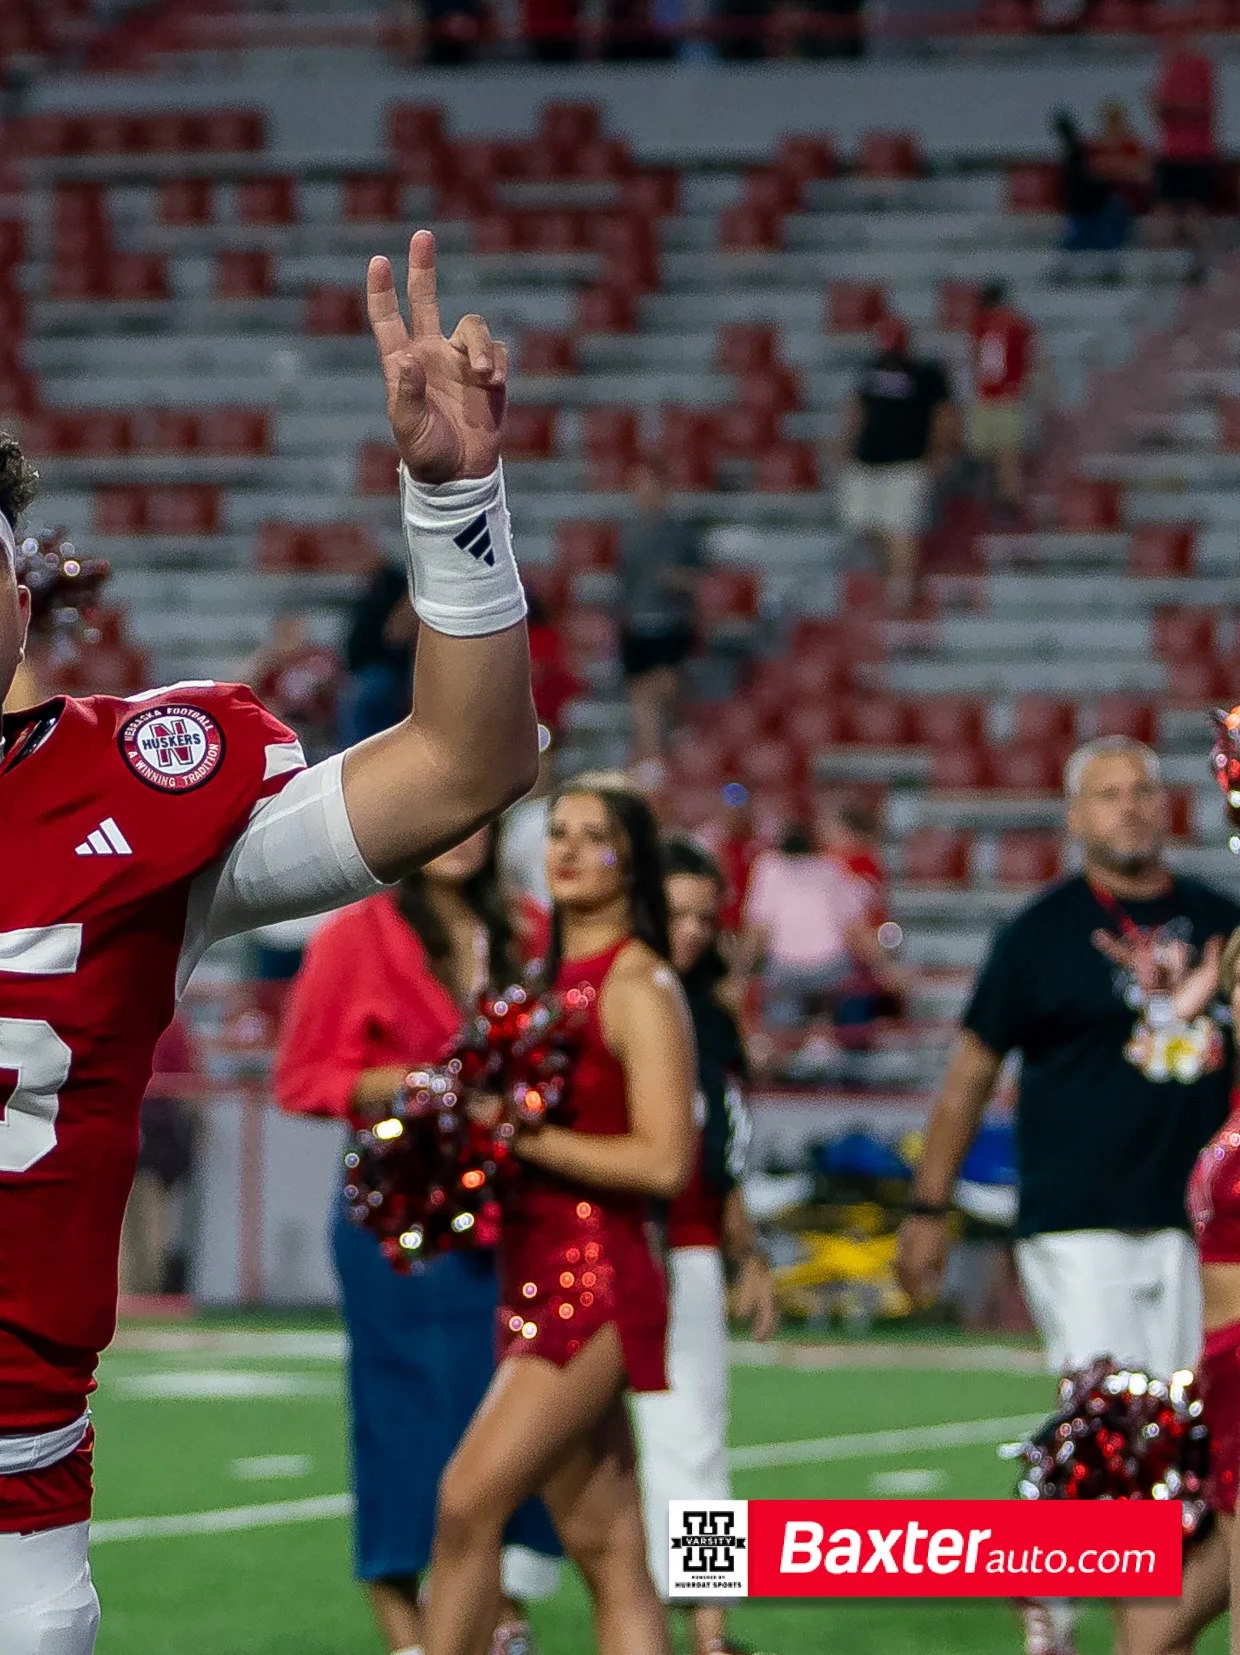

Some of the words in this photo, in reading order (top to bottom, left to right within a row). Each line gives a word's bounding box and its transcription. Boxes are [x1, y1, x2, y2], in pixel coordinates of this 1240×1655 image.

[124, 709, 162, 742] NEBRASKA
[166, 707, 214, 732] FOOTBALL
[142, 733, 201, 750] HUSKERS
[149, 719, 194, 767] N
[128, 751, 138, 759] A
[135, 760, 176, 787] WINNING
[182, 743, 219, 786] TRADITION
